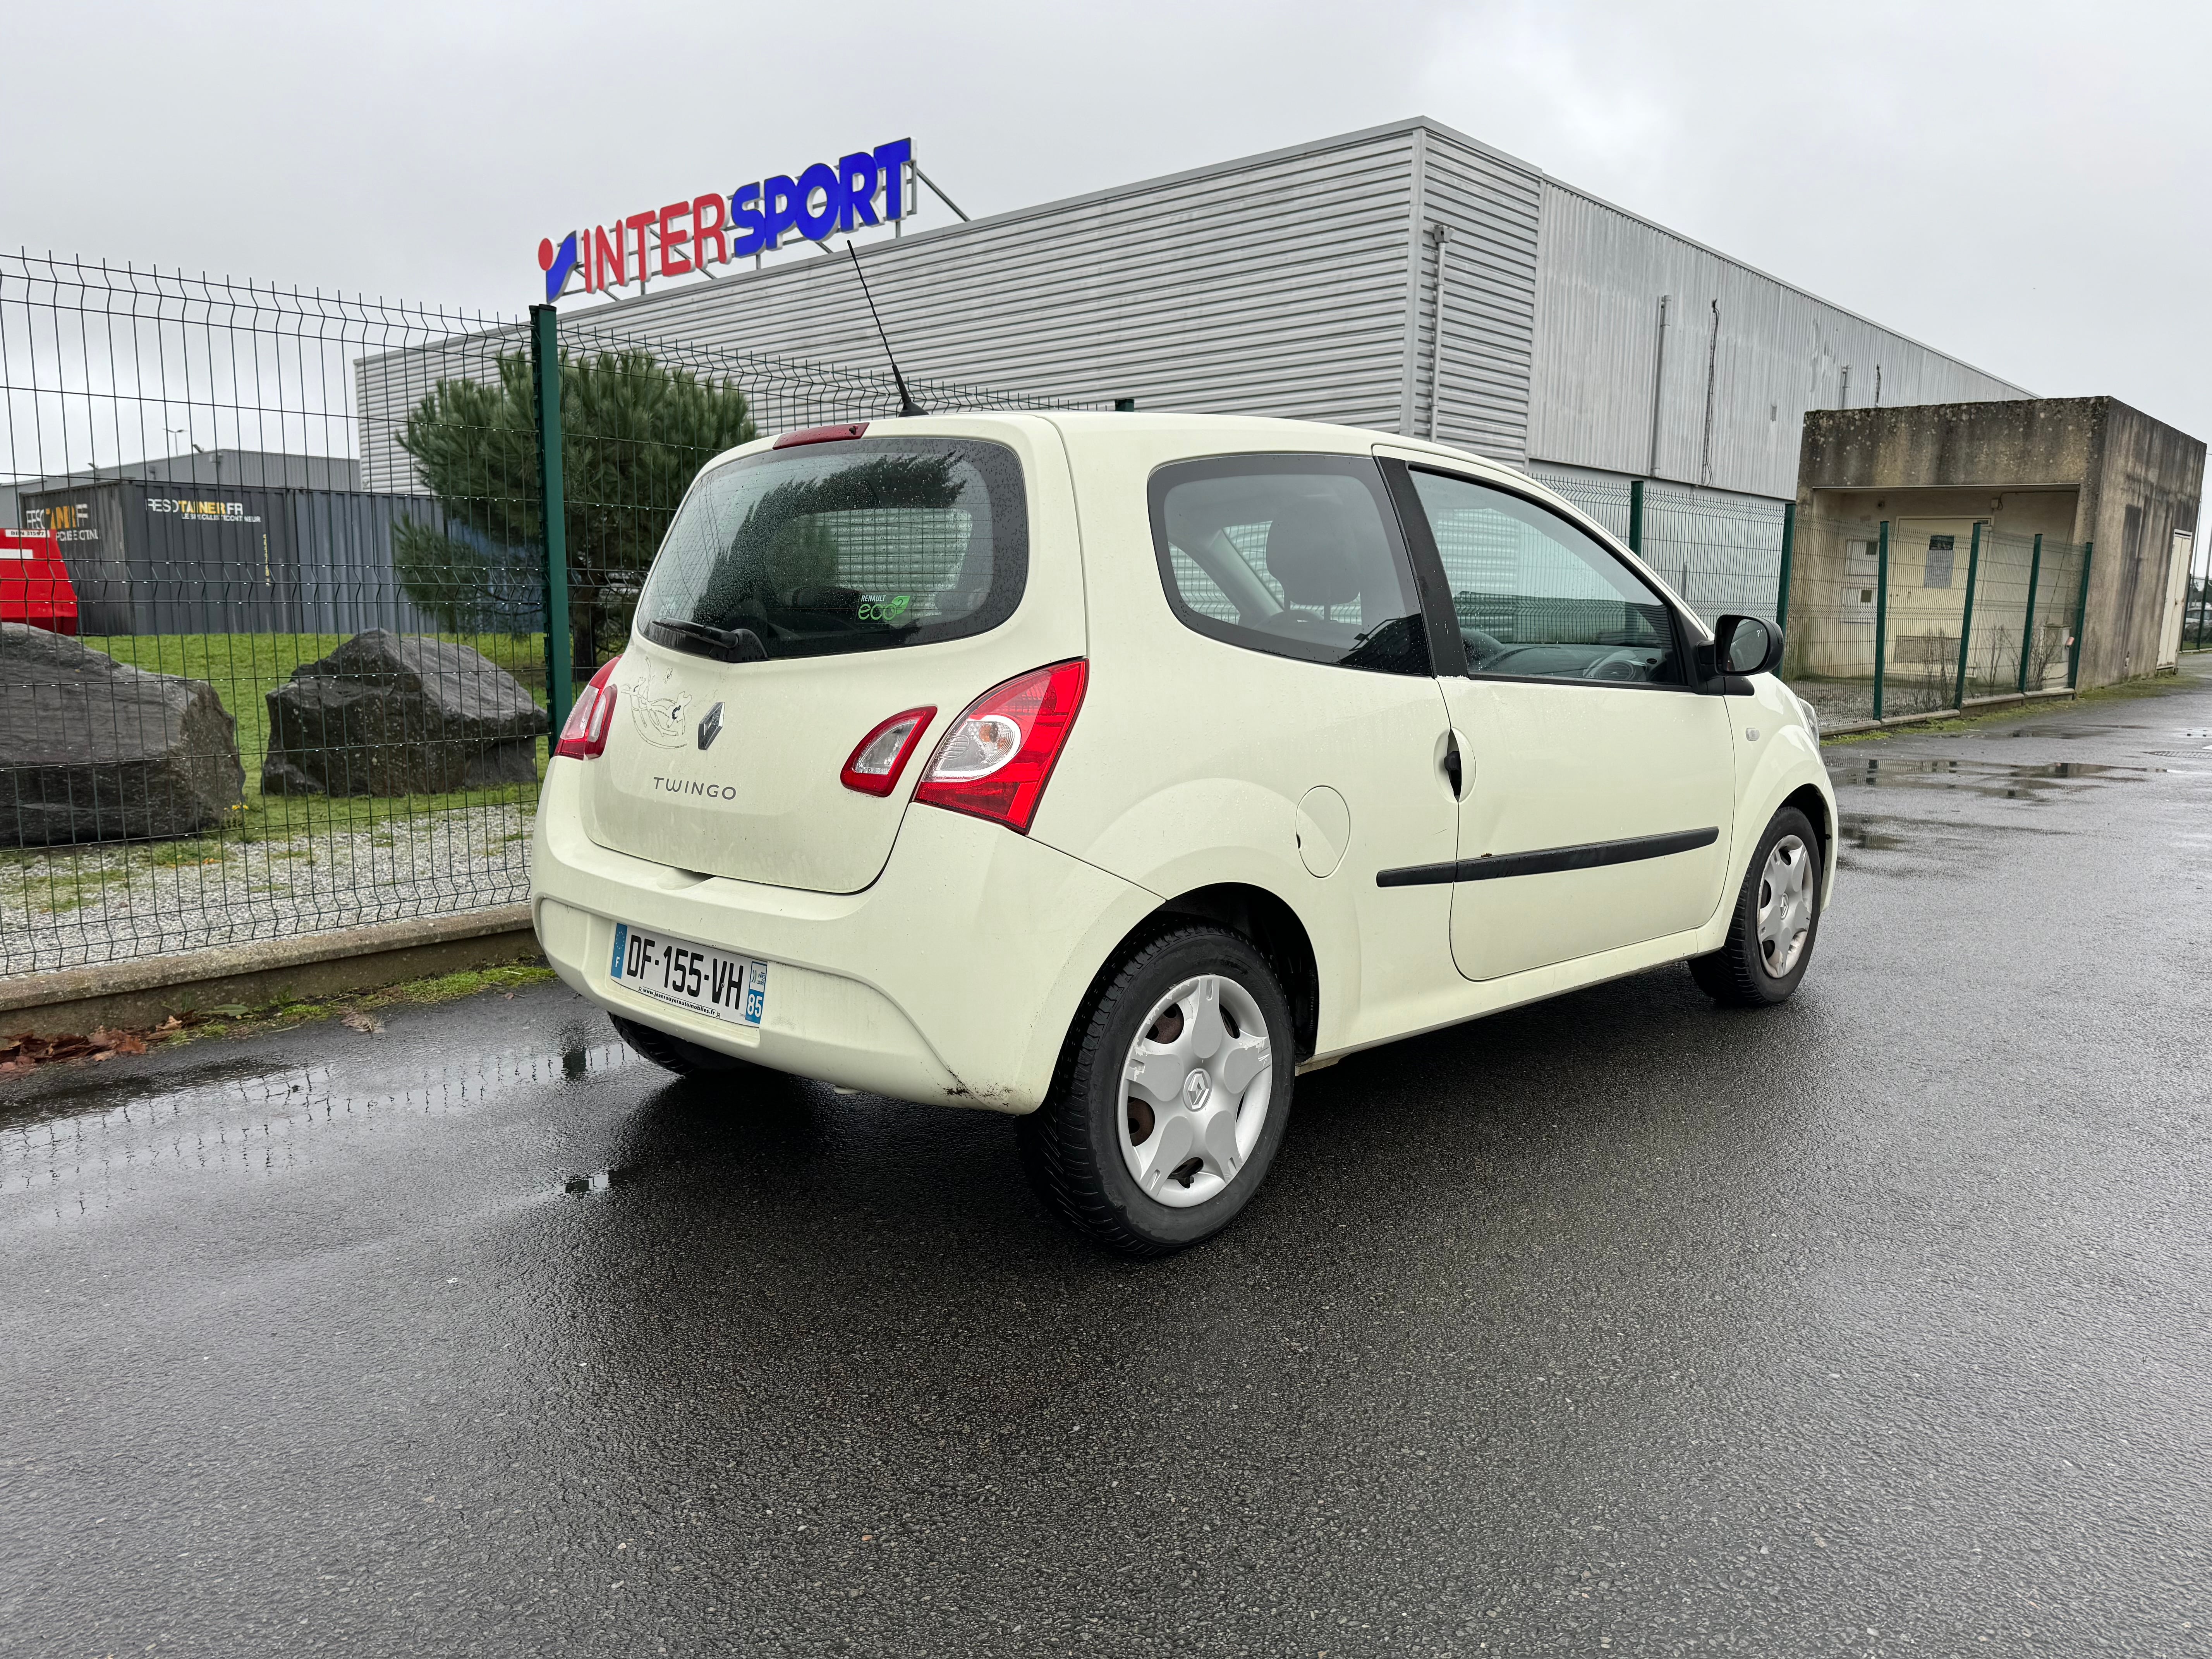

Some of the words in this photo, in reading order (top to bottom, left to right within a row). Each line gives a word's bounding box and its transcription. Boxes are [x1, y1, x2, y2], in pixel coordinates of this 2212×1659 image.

[583, 137, 917, 293] INTERSPORT
[653, 777, 736, 800] TWINGO
[615, 956, 620, 967] F
[627, 934, 744, 1010] DF-155-VH
[643, 988, 716, 1015] www.jeanrouyerautomobiles.fr
[747, 994, 763, 1017] 85
